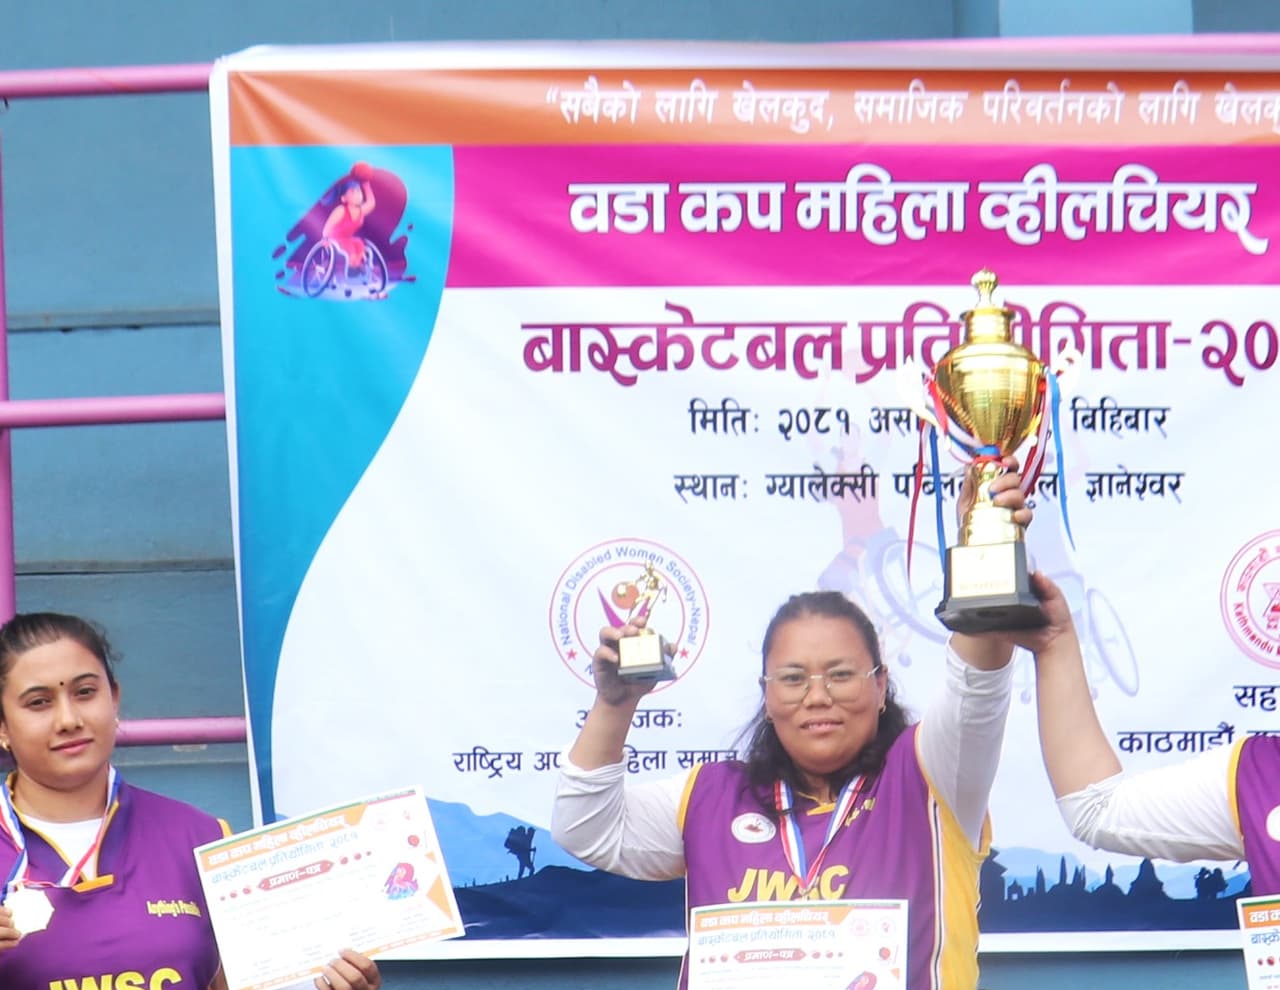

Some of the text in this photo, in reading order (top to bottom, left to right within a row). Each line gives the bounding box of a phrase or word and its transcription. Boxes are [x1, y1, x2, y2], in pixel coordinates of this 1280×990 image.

[655, 79, 719, 124] लागि
[854, 79, 968, 124] समाजिक
[983, 79, 1125, 126] परिवर्तनको
[1139, 81, 1201, 126] लागि
[568, 162, 1269, 255] वडा कप महिला व्हीलचियर
[520, 300, 848, 387] बास्केटबल
[778, 407, 851, 441] २०८१
[1071, 396, 1172, 439] बिहिबार
[765, 464, 880, 503] ग्यालेक्सी
[1085, 465, 1186, 504] ज्ञानेश्वर
[565, 549, 612, 590] Disabled
[615, 546, 665, 565] Women
[559, 591, 572, 646] National
[1233, 602, 1274, 653] Kathmandu
[452, 746, 523, 779] राष्ट्रिय
